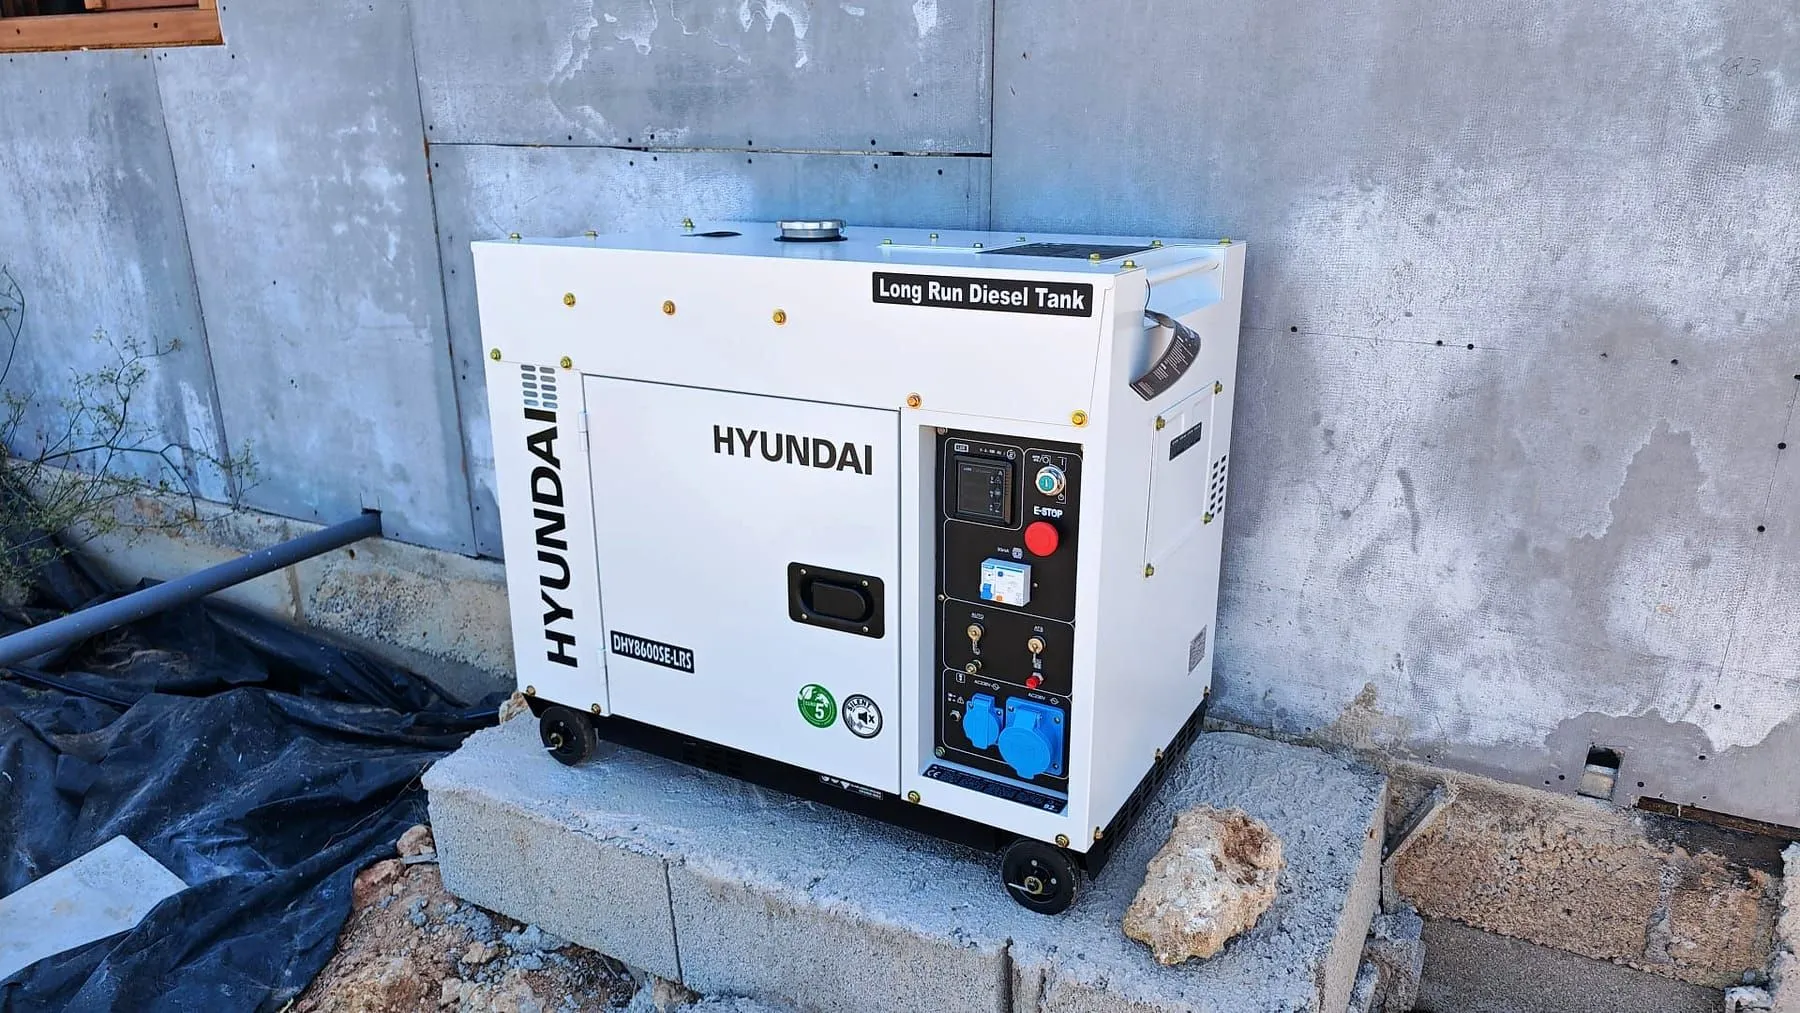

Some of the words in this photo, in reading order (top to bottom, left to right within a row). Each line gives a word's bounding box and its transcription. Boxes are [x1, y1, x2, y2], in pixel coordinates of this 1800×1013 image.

[879, 278, 922, 304] Long
[928, 281, 963, 302] Run
[969, 283, 1028, 306] Diesel
[1035, 287, 1085, 310] Tank
[713, 424, 873, 476] HYUNDAI
[1033, 506, 1063, 519] E-STOP
[523, 407, 578, 668] HYUNDAI
[613, 634, 692, 669] DHY8600SE-LRS
[814, 702, 825, 720] 5
[847, 698, 872, 713] SILENT
